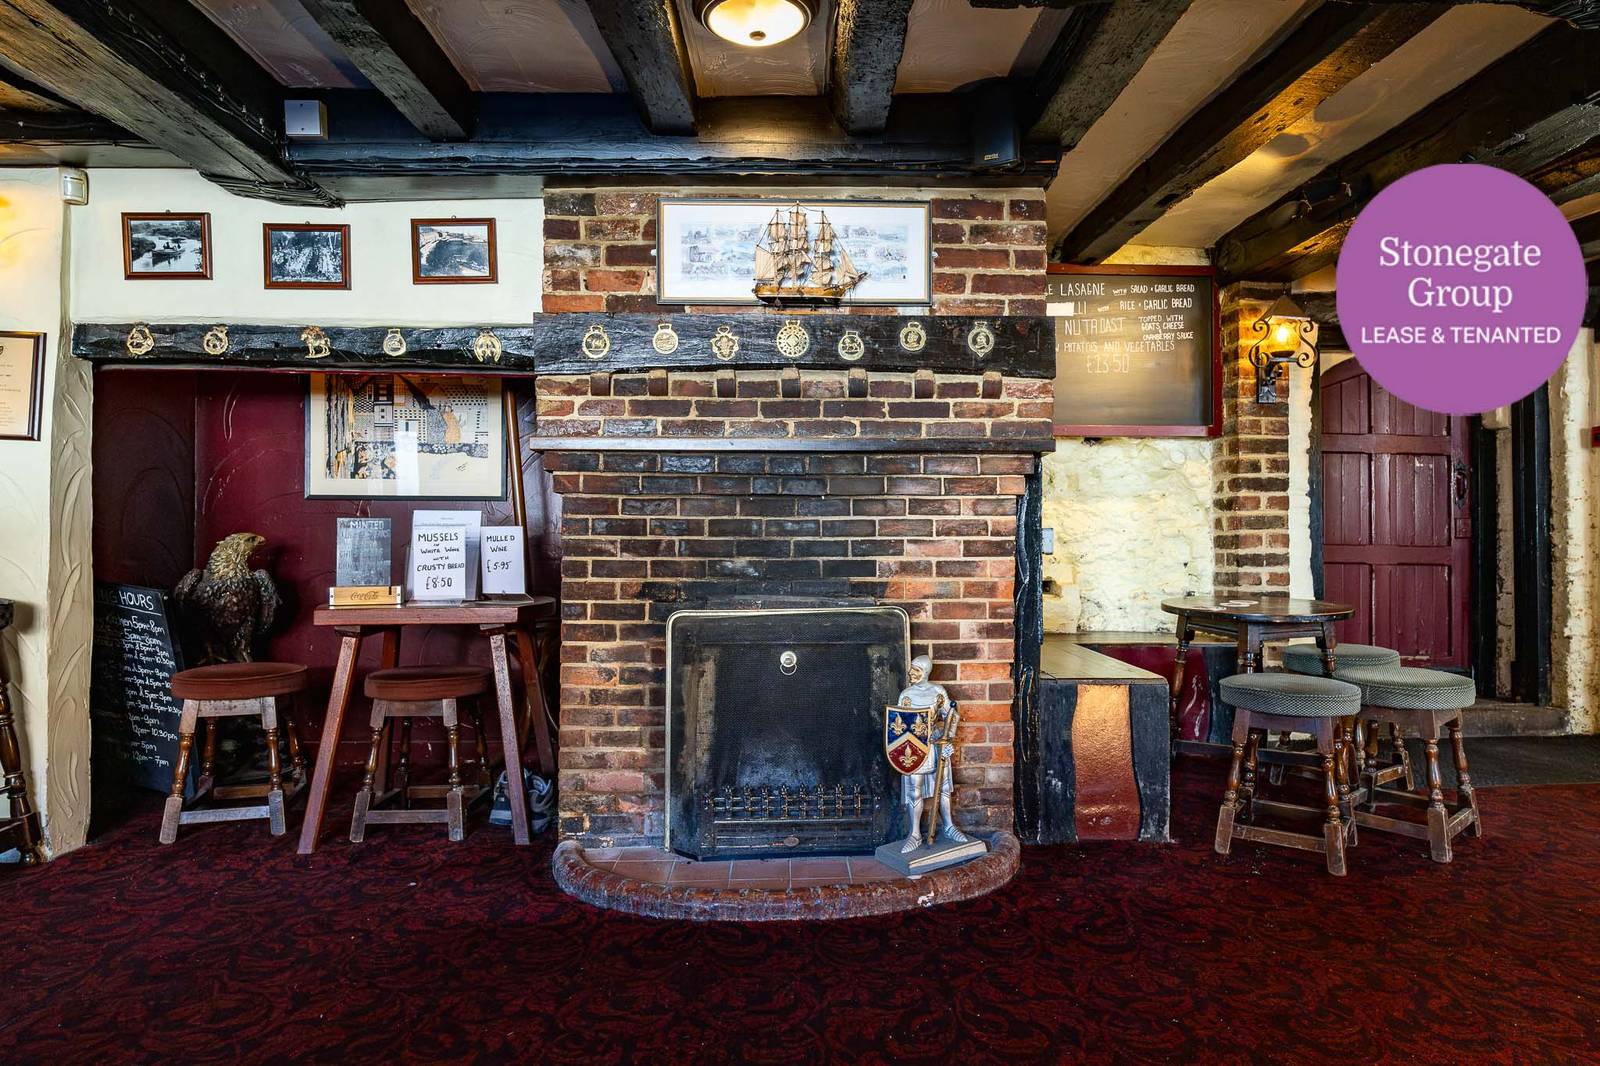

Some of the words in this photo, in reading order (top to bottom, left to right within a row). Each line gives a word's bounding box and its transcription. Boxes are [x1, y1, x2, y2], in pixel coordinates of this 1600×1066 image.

[1060, 282, 1105, 296] LASAGNE
[1176, 284, 1195, 293] BREAD
[1119, 300, 1136, 311] RICE
[1143, 298, 1169, 311] GARLIC
[1171, 297, 1193, 309] BREAD
[1138, 315, 1163, 324] TOPPED
[1166, 314, 1184, 322] WITH
[1162, 321, 1185, 330] CHEESE
[1177, 331, 1194, 341] SAUCE
[1125, 340, 1175, 353] VEGETABLES
[417, 532, 459, 542] MUSSELS
[489, 545, 508, 553] WINE
[417, 563, 446, 572] CRUSTY
[447, 562, 465, 570] BREAD
[118, 588, 154, 611] HOURS
